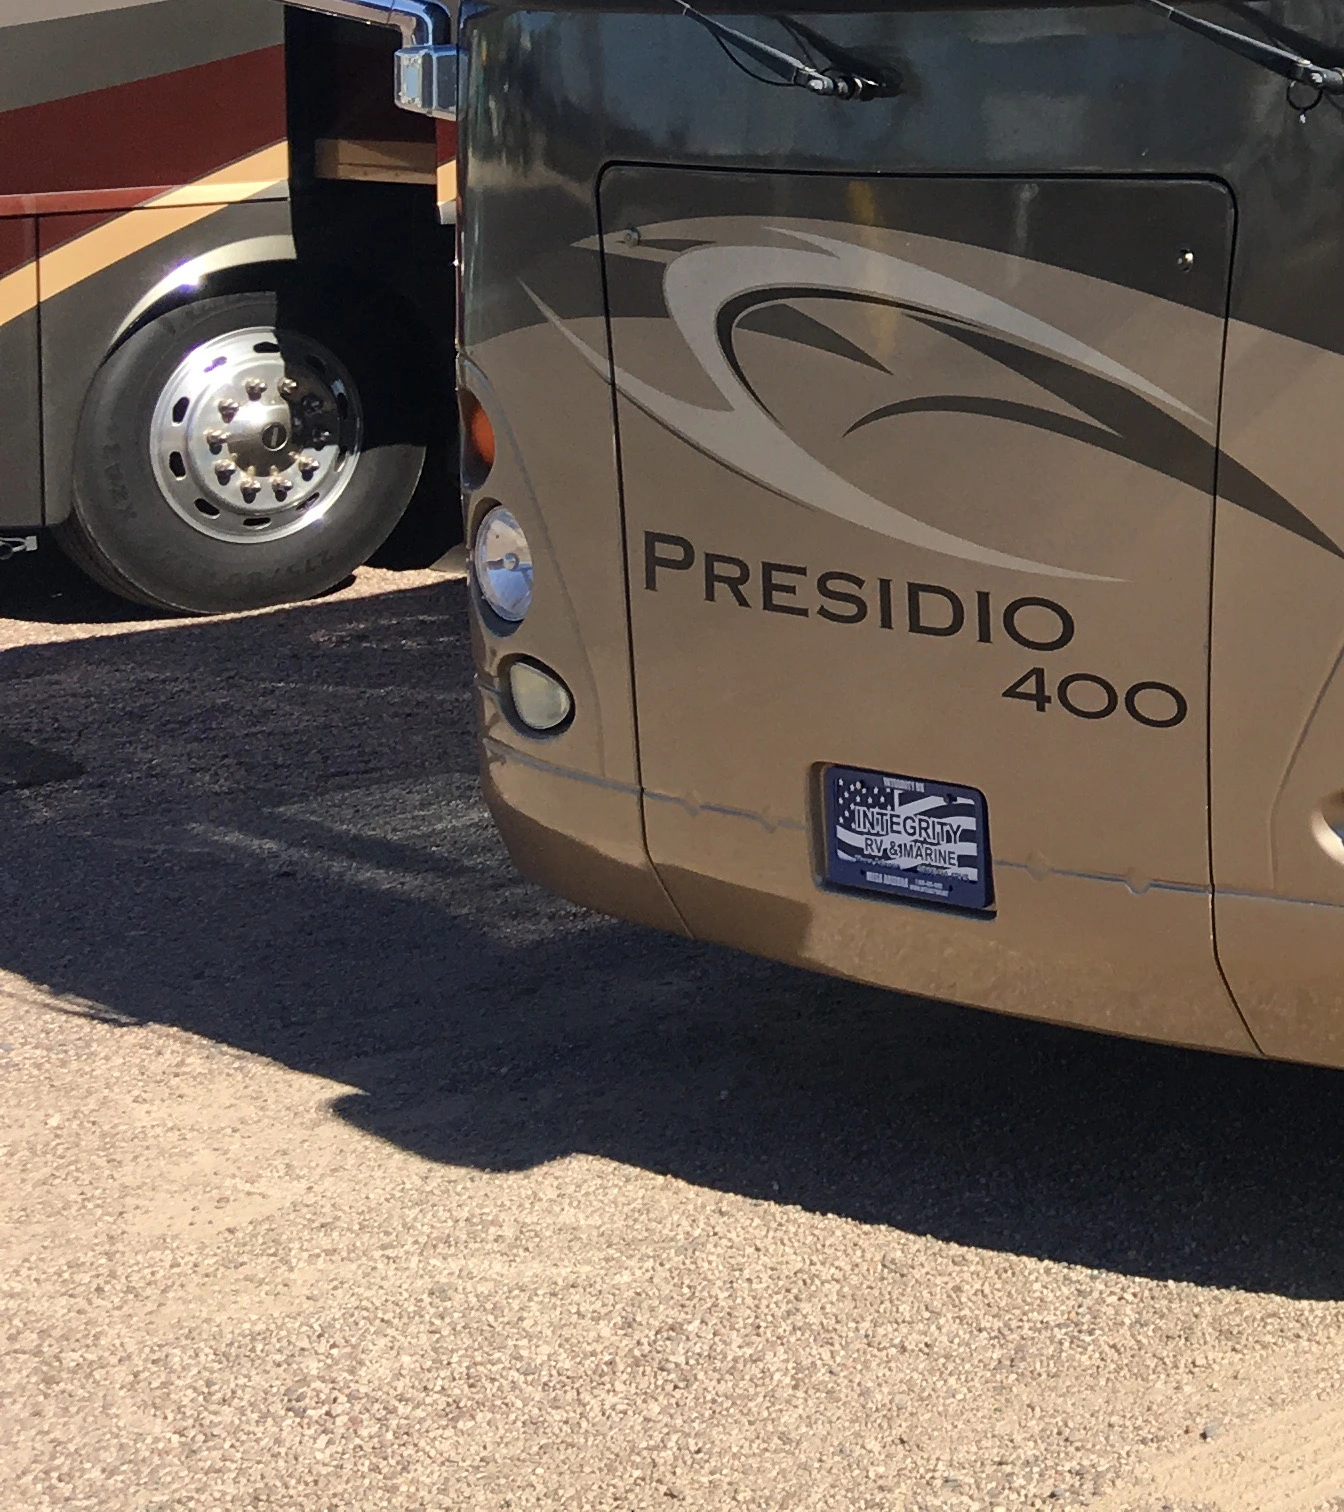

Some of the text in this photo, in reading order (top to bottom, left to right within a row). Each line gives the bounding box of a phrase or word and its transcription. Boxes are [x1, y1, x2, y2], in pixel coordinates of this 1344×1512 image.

[643, 530, 1075, 652] PRESIDIO
[1001, 666, 1188, 729] 400
[856, 806, 962, 844] INTEGRITY
[865, 837, 883, 854] RV
[889, 840, 901, 856] &
[903, 842, 957, 866] MARINE
